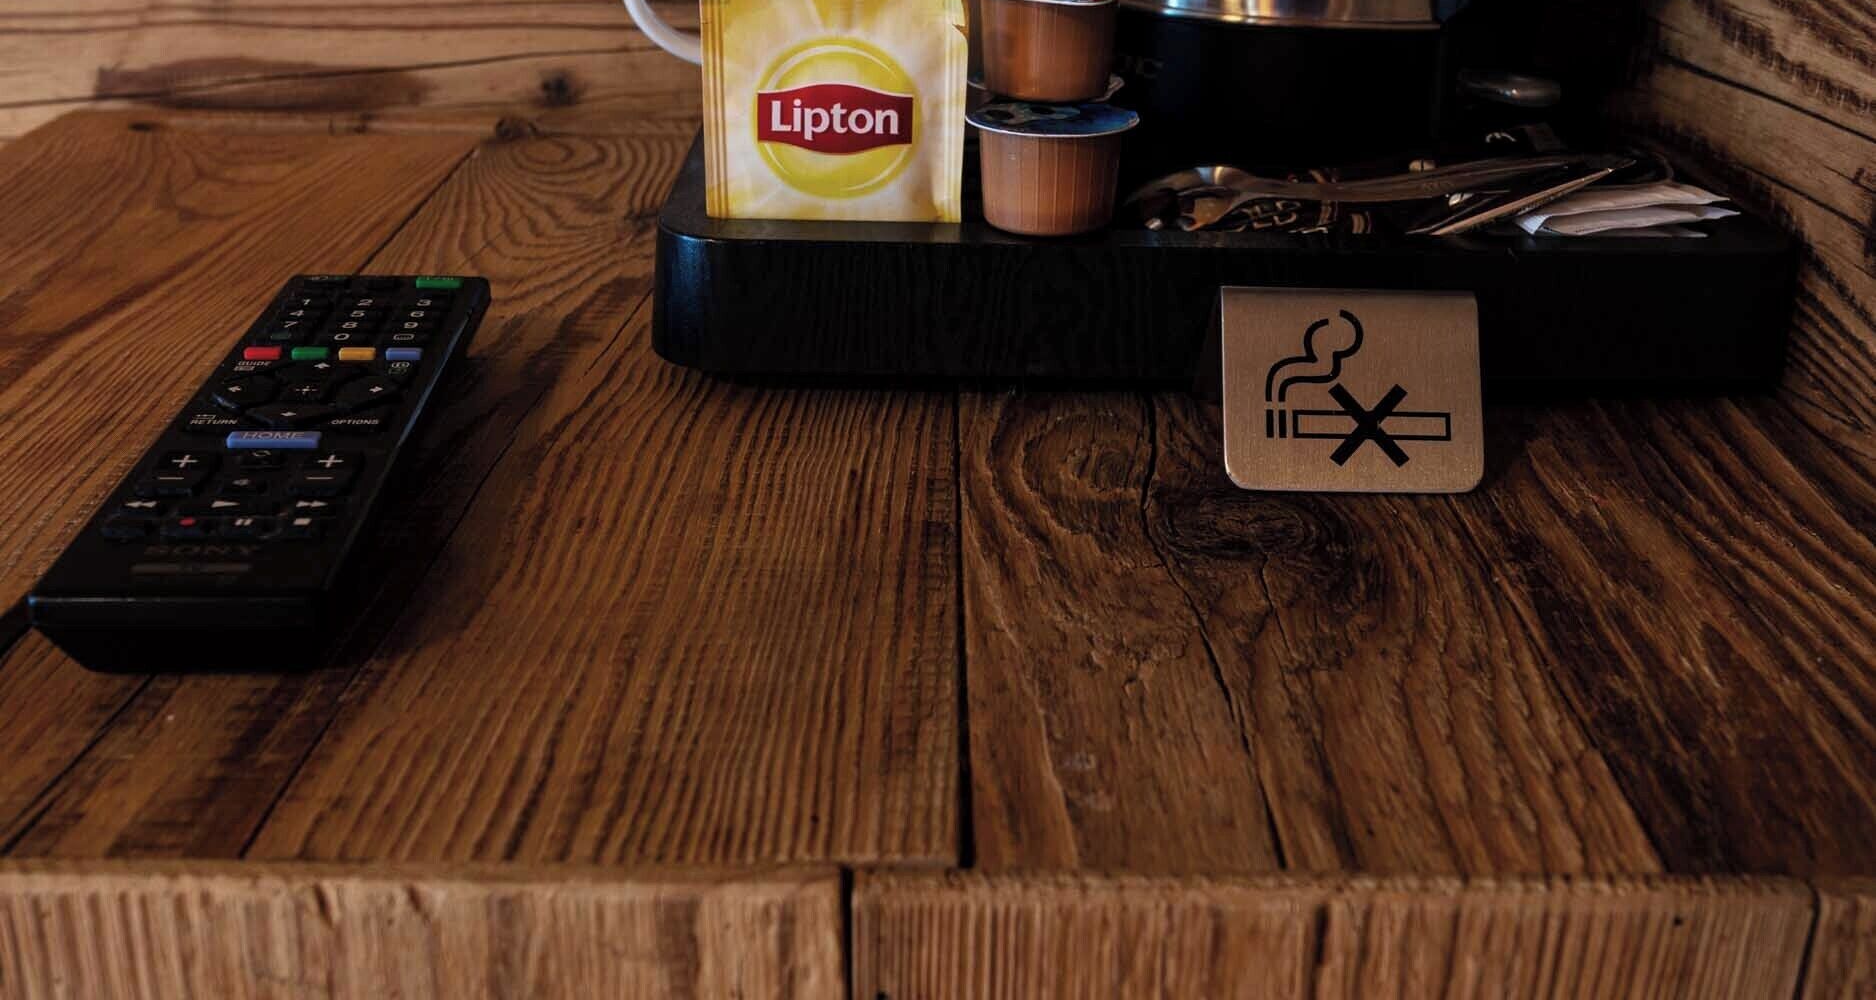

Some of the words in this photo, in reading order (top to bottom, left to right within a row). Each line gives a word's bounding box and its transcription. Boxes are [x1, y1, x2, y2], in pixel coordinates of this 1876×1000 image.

[771, 98, 899, 141] Lipton
[357, 298, 374, 306] 2
[416, 298, 432, 307] 3
[289, 309, 304, 317] 4
[350, 310, 365, 318] 5
[410, 310, 425, 318] 6
[342, 321, 358, 329] 8
[403, 321, 419, 329] 9
[333, 332, 351, 341] 0
[241, 431, 305, 440] HOME
